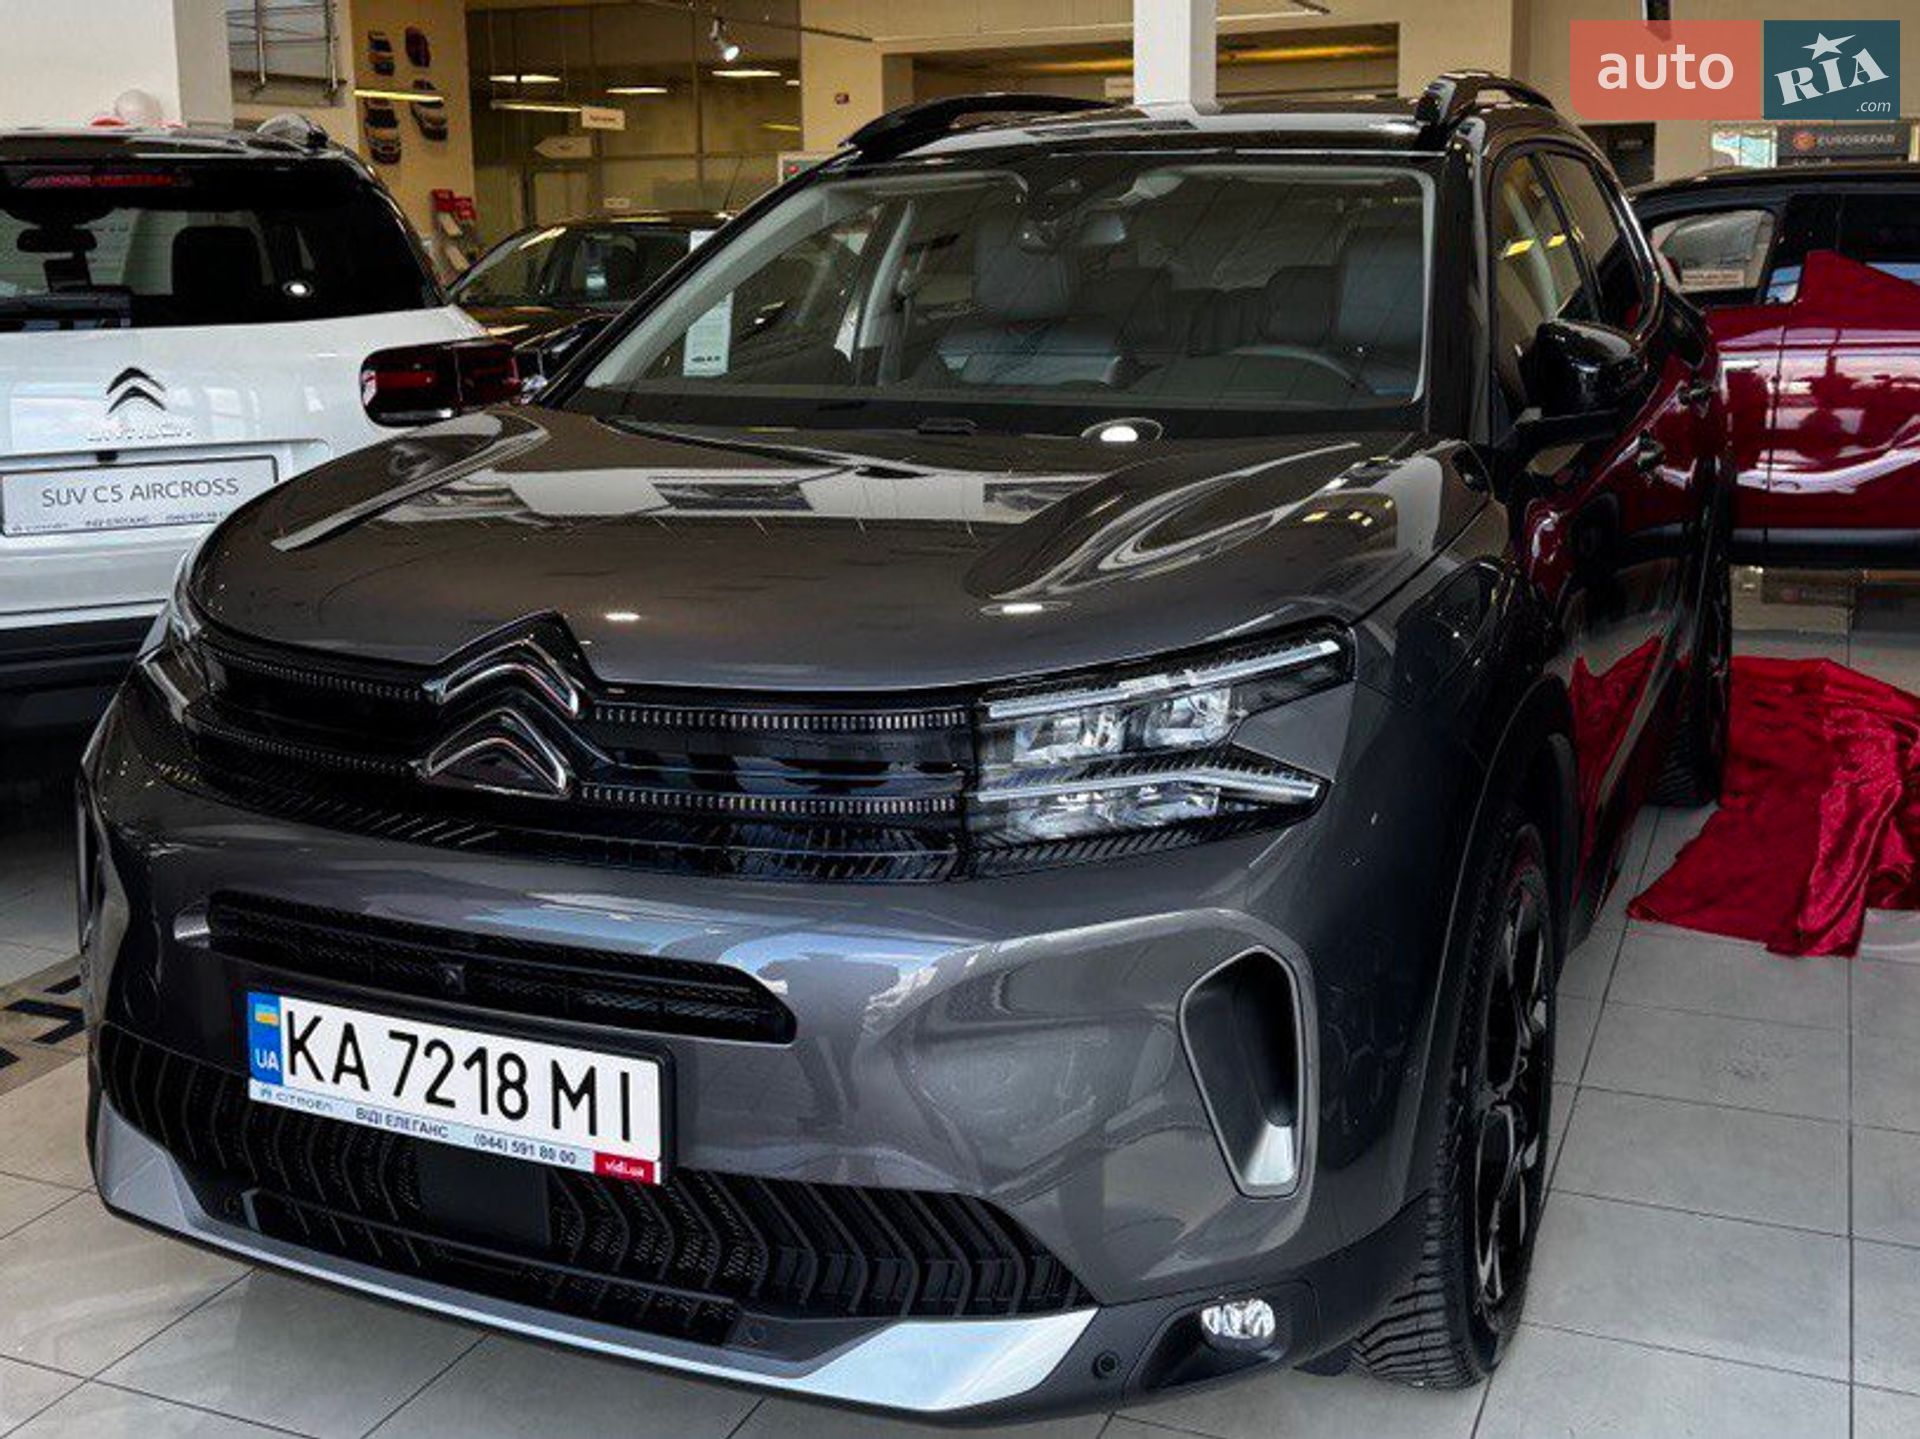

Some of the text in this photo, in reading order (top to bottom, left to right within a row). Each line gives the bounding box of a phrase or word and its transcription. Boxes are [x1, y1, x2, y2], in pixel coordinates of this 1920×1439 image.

[41, 477, 240, 508] SUV C5 AIRCROSS
[254, 1048, 280, 1071] UA
[287, 1010, 631, 1142] KA 7218 MI
[385, 1114, 449, 1139] ЕЛЕГАНС
[473, 1132, 508, 1151] (044)
[511, 1140, 535, 1157] 591
